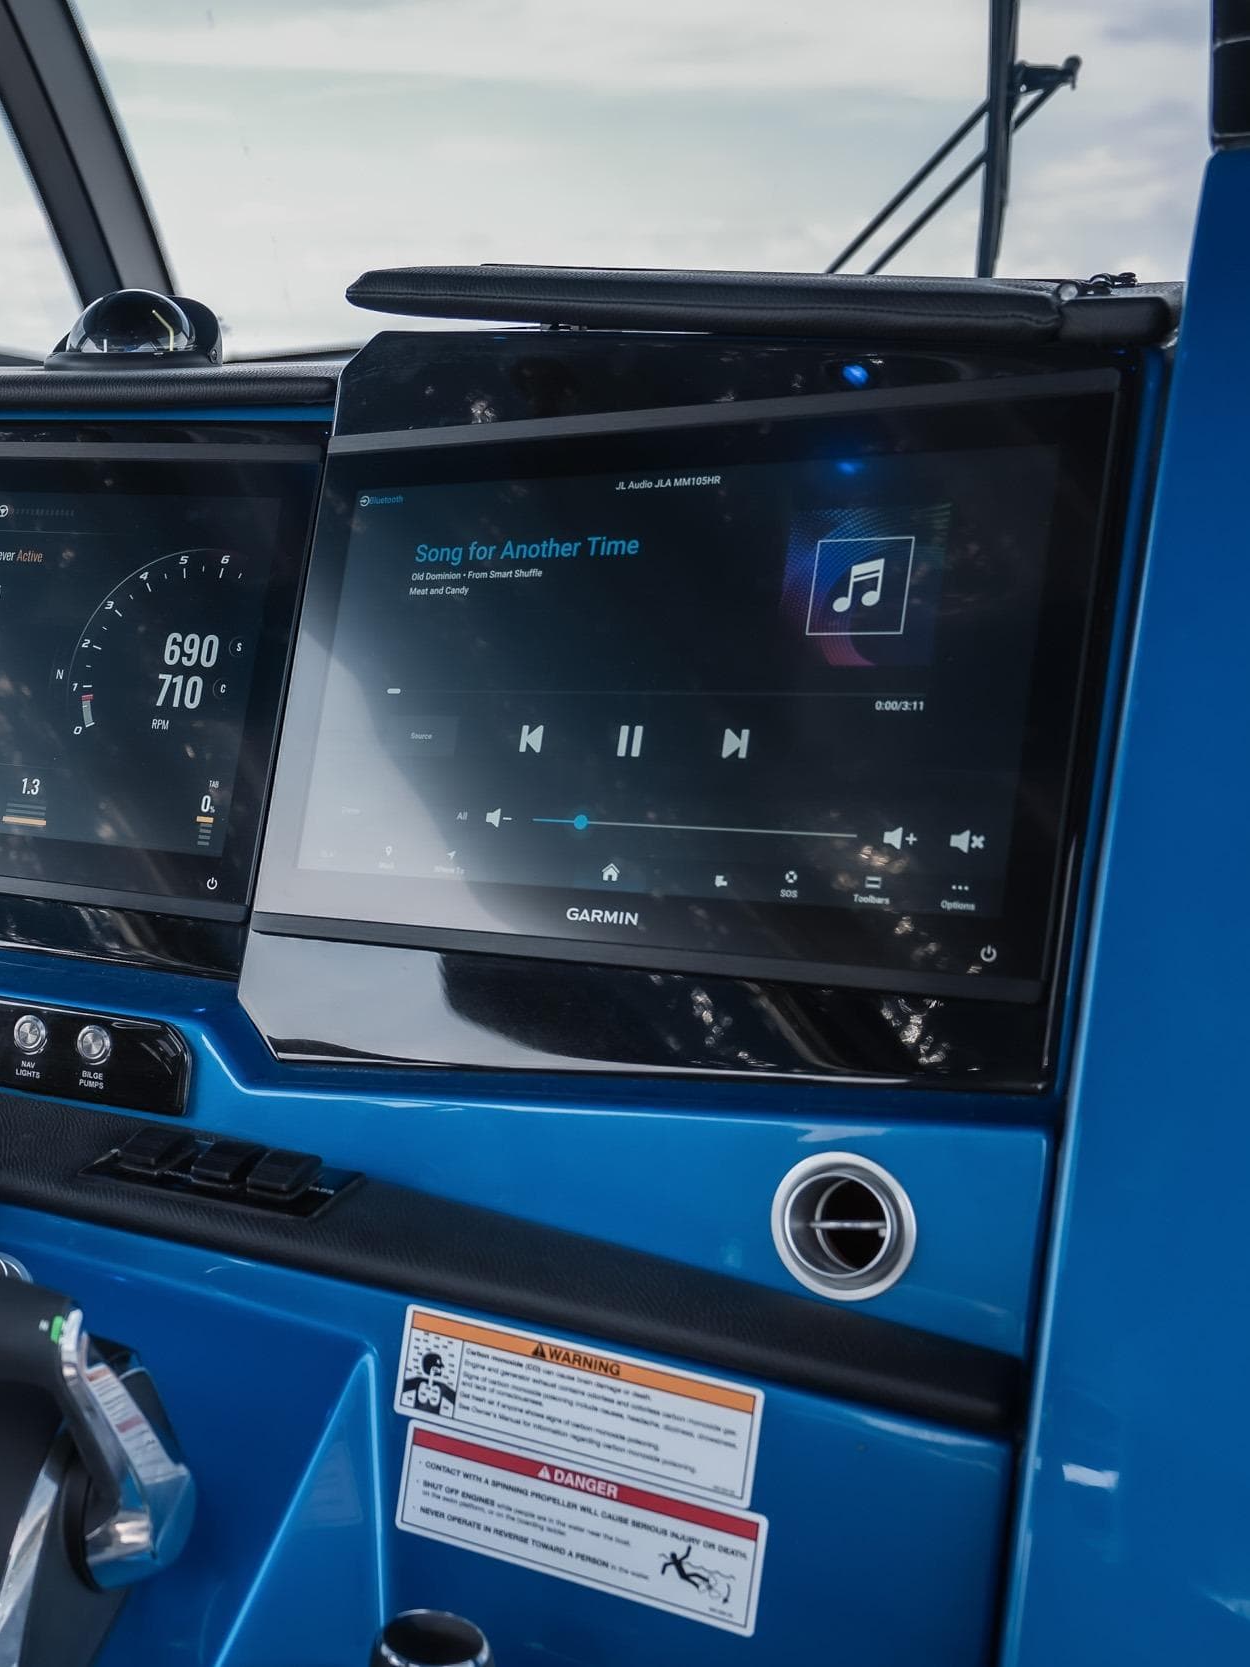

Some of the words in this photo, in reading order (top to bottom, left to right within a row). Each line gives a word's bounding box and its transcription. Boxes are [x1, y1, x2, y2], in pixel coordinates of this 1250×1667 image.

[615, 481, 626, 491] JL
[627, 480, 653, 490] Audio
[654, 479, 672, 488] JLA
[673, 475, 721, 487] MM105HR
[368, 495, 404, 505] Bluetooth
[16, 550, 43, 563] Active
[414, 543, 464, 566] Song
[468, 541, 496, 561] for
[500, 538, 581, 560] Another
[587, 536, 640, 556] Time
[178, 555, 189, 565] 5
[221, 555, 230, 564] 6
[139, 571, 149, 581] 4
[411, 571, 425, 581] Old
[425, 571, 461, 581] Dominion
[467, 570, 488, 579] From
[489, 569, 513, 579] Smart
[514, 568, 543, 578] Shuffle
[409, 587, 429, 596] Meat
[429, 586, 444, 595] and
[445, 586, 470, 596] Candy
[104, 600, 114, 610] 3
[81, 639, 91, 648] 2
[163, 632, 220, 668] 690
[236, 642, 243, 652] S
[55, 669, 64, 680] N
[72, 683, 78, 691] 1
[155, 673, 204, 710] 710
[220, 684, 226, 694] C
[875, 700, 924, 711] 0:00/3:11
[151, 718, 169, 731] RPM
[73, 726, 83, 735] 0
[410, 732, 433, 740] Source
[21, 777, 41, 796] 1.3
[456, 812, 468, 821] All
[780, 889, 798, 898] SOS
[853, 893, 890, 905] Toolbars
[941, 899, 976, 911] Options
[566, 907, 639, 926] GARMIN
[21, 1060, 36, 1069] NAV
[15, 1068, 41, 1079] LIGHTS
[81, 1070, 103, 1080] BILGE
[79, 1079, 104, 1090] PUMPS
[549, 1347, 622, 1377] WARNING
[553, 1470, 619, 1500] DANGER
[421, 1480, 443, 1491] SHUT
[444, 1486, 459, 1496] OFF
[460, 1491, 495, 1506] ENGINES
[424, 1460, 461, 1476] CONTACT
[461, 1471, 482, 1482] WITH
[489, 1479, 529, 1496] SPINNING
[529, 1490, 578, 1510] PROPELLER
[579, 1504, 599, 1516] WILL
[600, 1510, 629, 1524] CAUSE
[630, 1519, 668, 1536] SERIOUS
[418, 1506, 445, 1519] NEVER
[445, 1514, 482, 1530] OPERATE
[492, 1528, 529, 1544] REVERSE
[530, 1539, 566, 1555] TOWARD
[574, 1552, 609, 1568] PERSON
